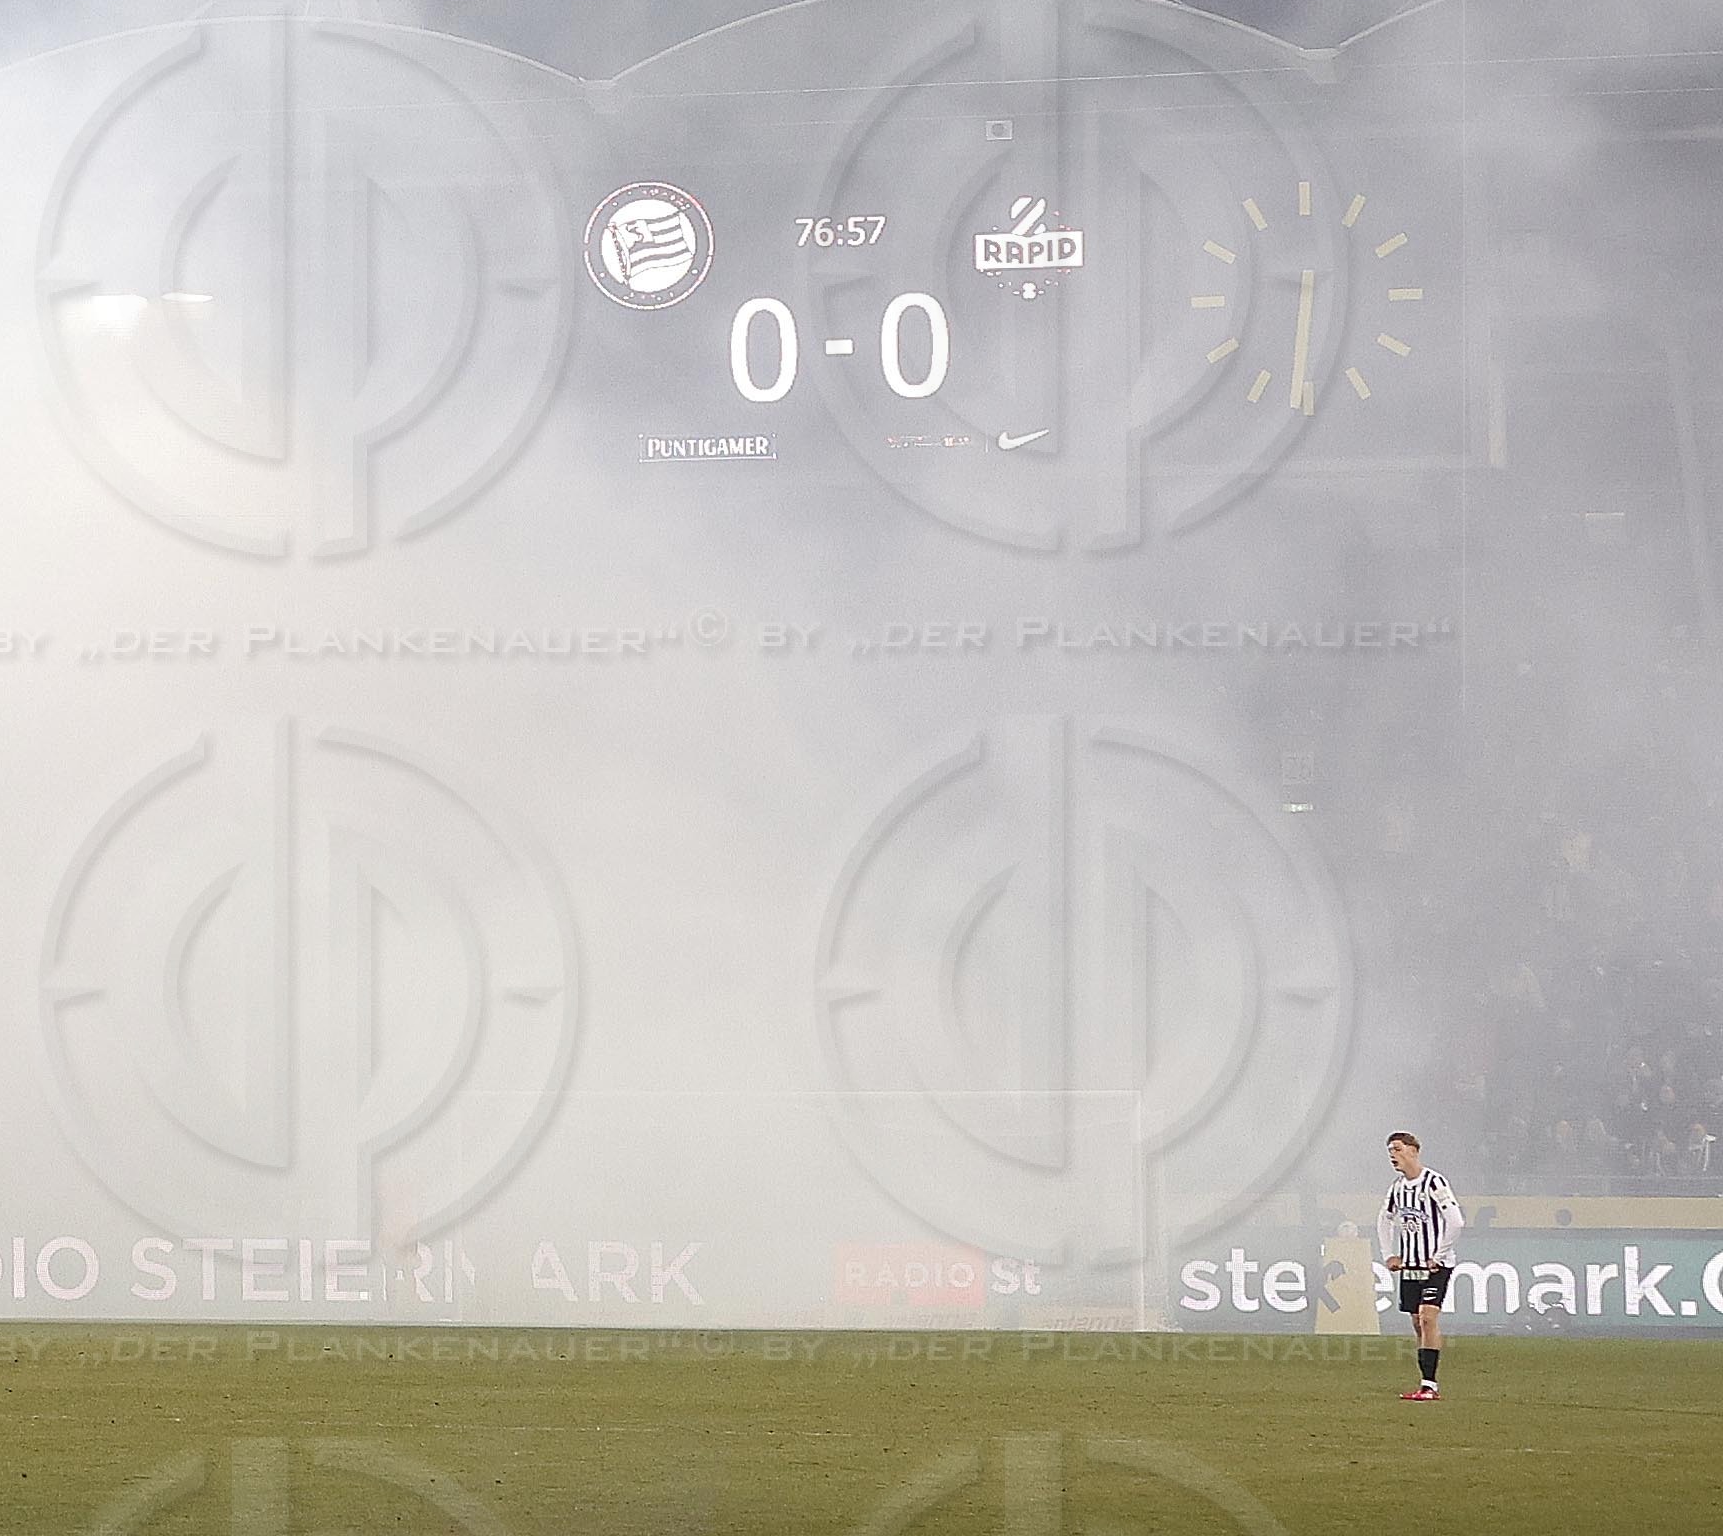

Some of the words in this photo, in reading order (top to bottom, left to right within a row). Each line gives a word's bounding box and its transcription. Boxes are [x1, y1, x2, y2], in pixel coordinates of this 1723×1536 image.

[795, 216, 887, 248] 76:57
[984, 238, 1077, 264] RAPID
[647, 435, 769, 457] PUNTIGAMER
[844, 1260, 976, 1288] RADIO
